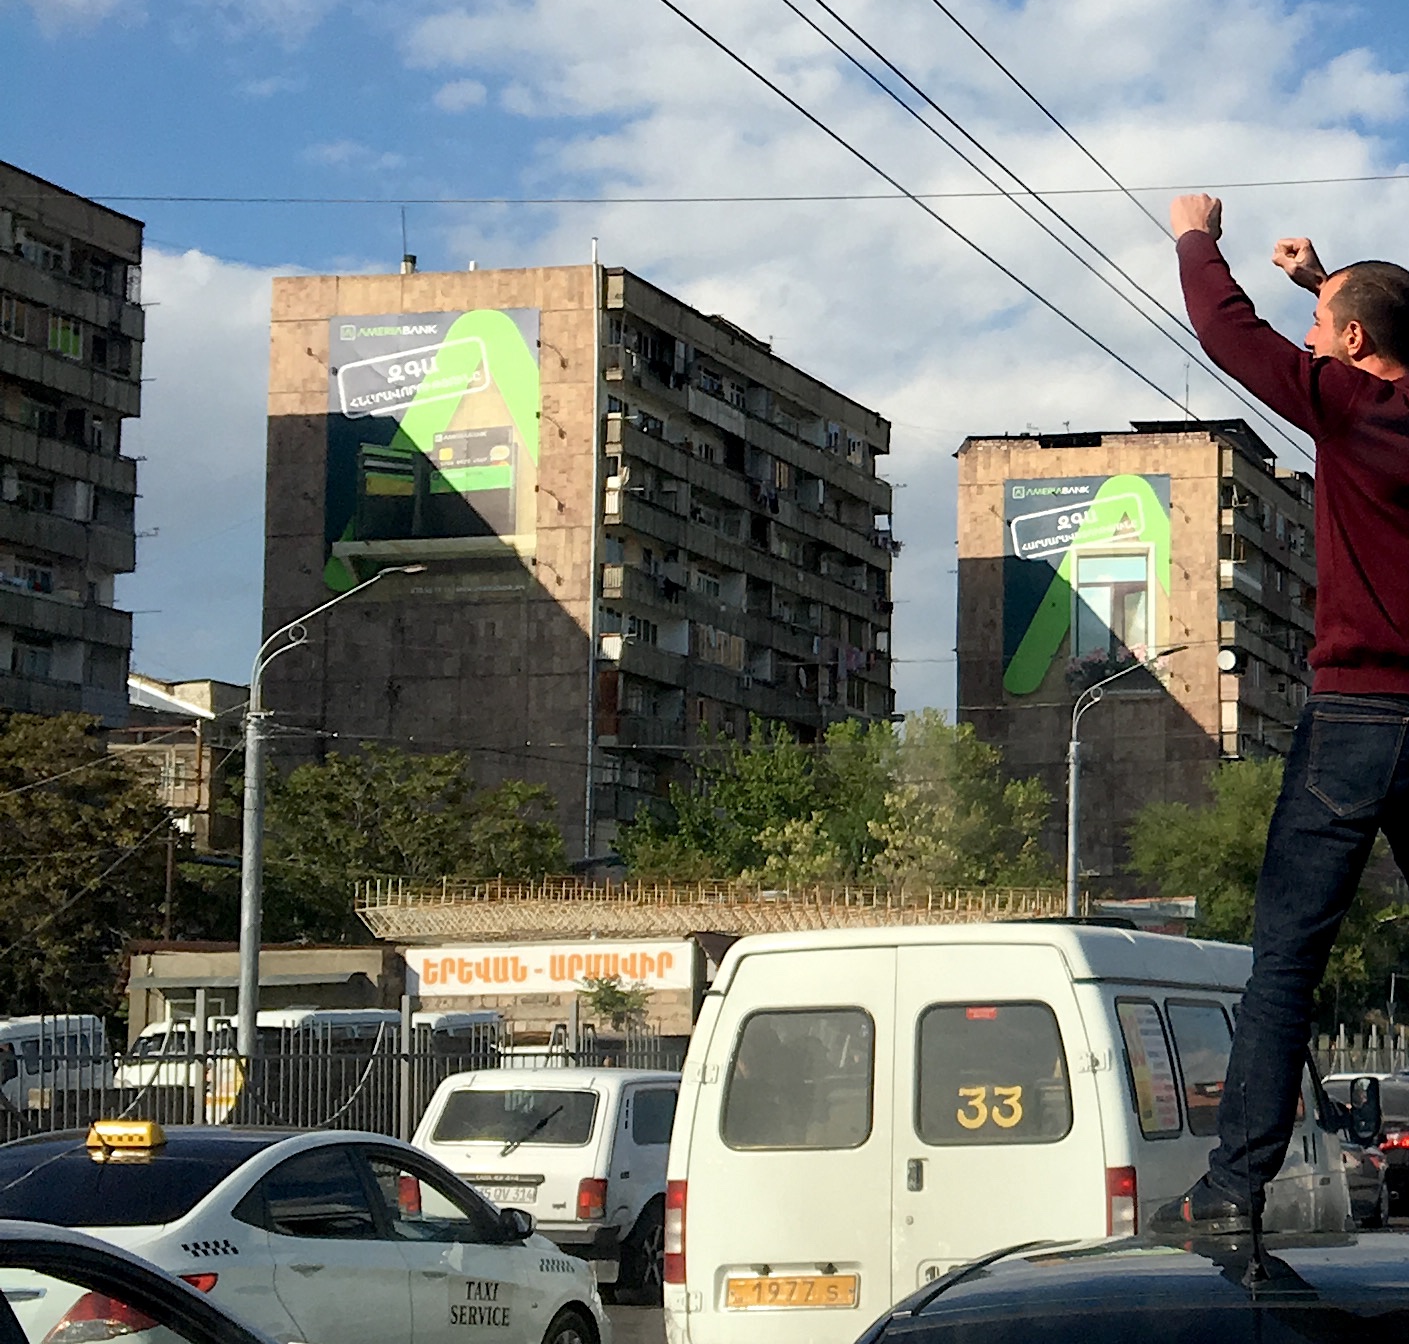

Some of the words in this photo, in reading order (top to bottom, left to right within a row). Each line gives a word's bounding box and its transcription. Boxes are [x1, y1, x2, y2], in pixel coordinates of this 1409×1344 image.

[357, 324, 438, 337] AMERIABANK
[1026, 485, 1090, 496] AMERIABANK
[422, 955, 528, 986] ԵՐԵՎԱՆ
[549, 950, 674, 982] ԱՐՄԱՎԻՐ
[957, 1085, 1023, 1129] 33
[466, 1281, 499, 1302] TAXI
[752, 1281, 815, 1304] 1977
[450, 1305, 510, 1327] SERVICE
